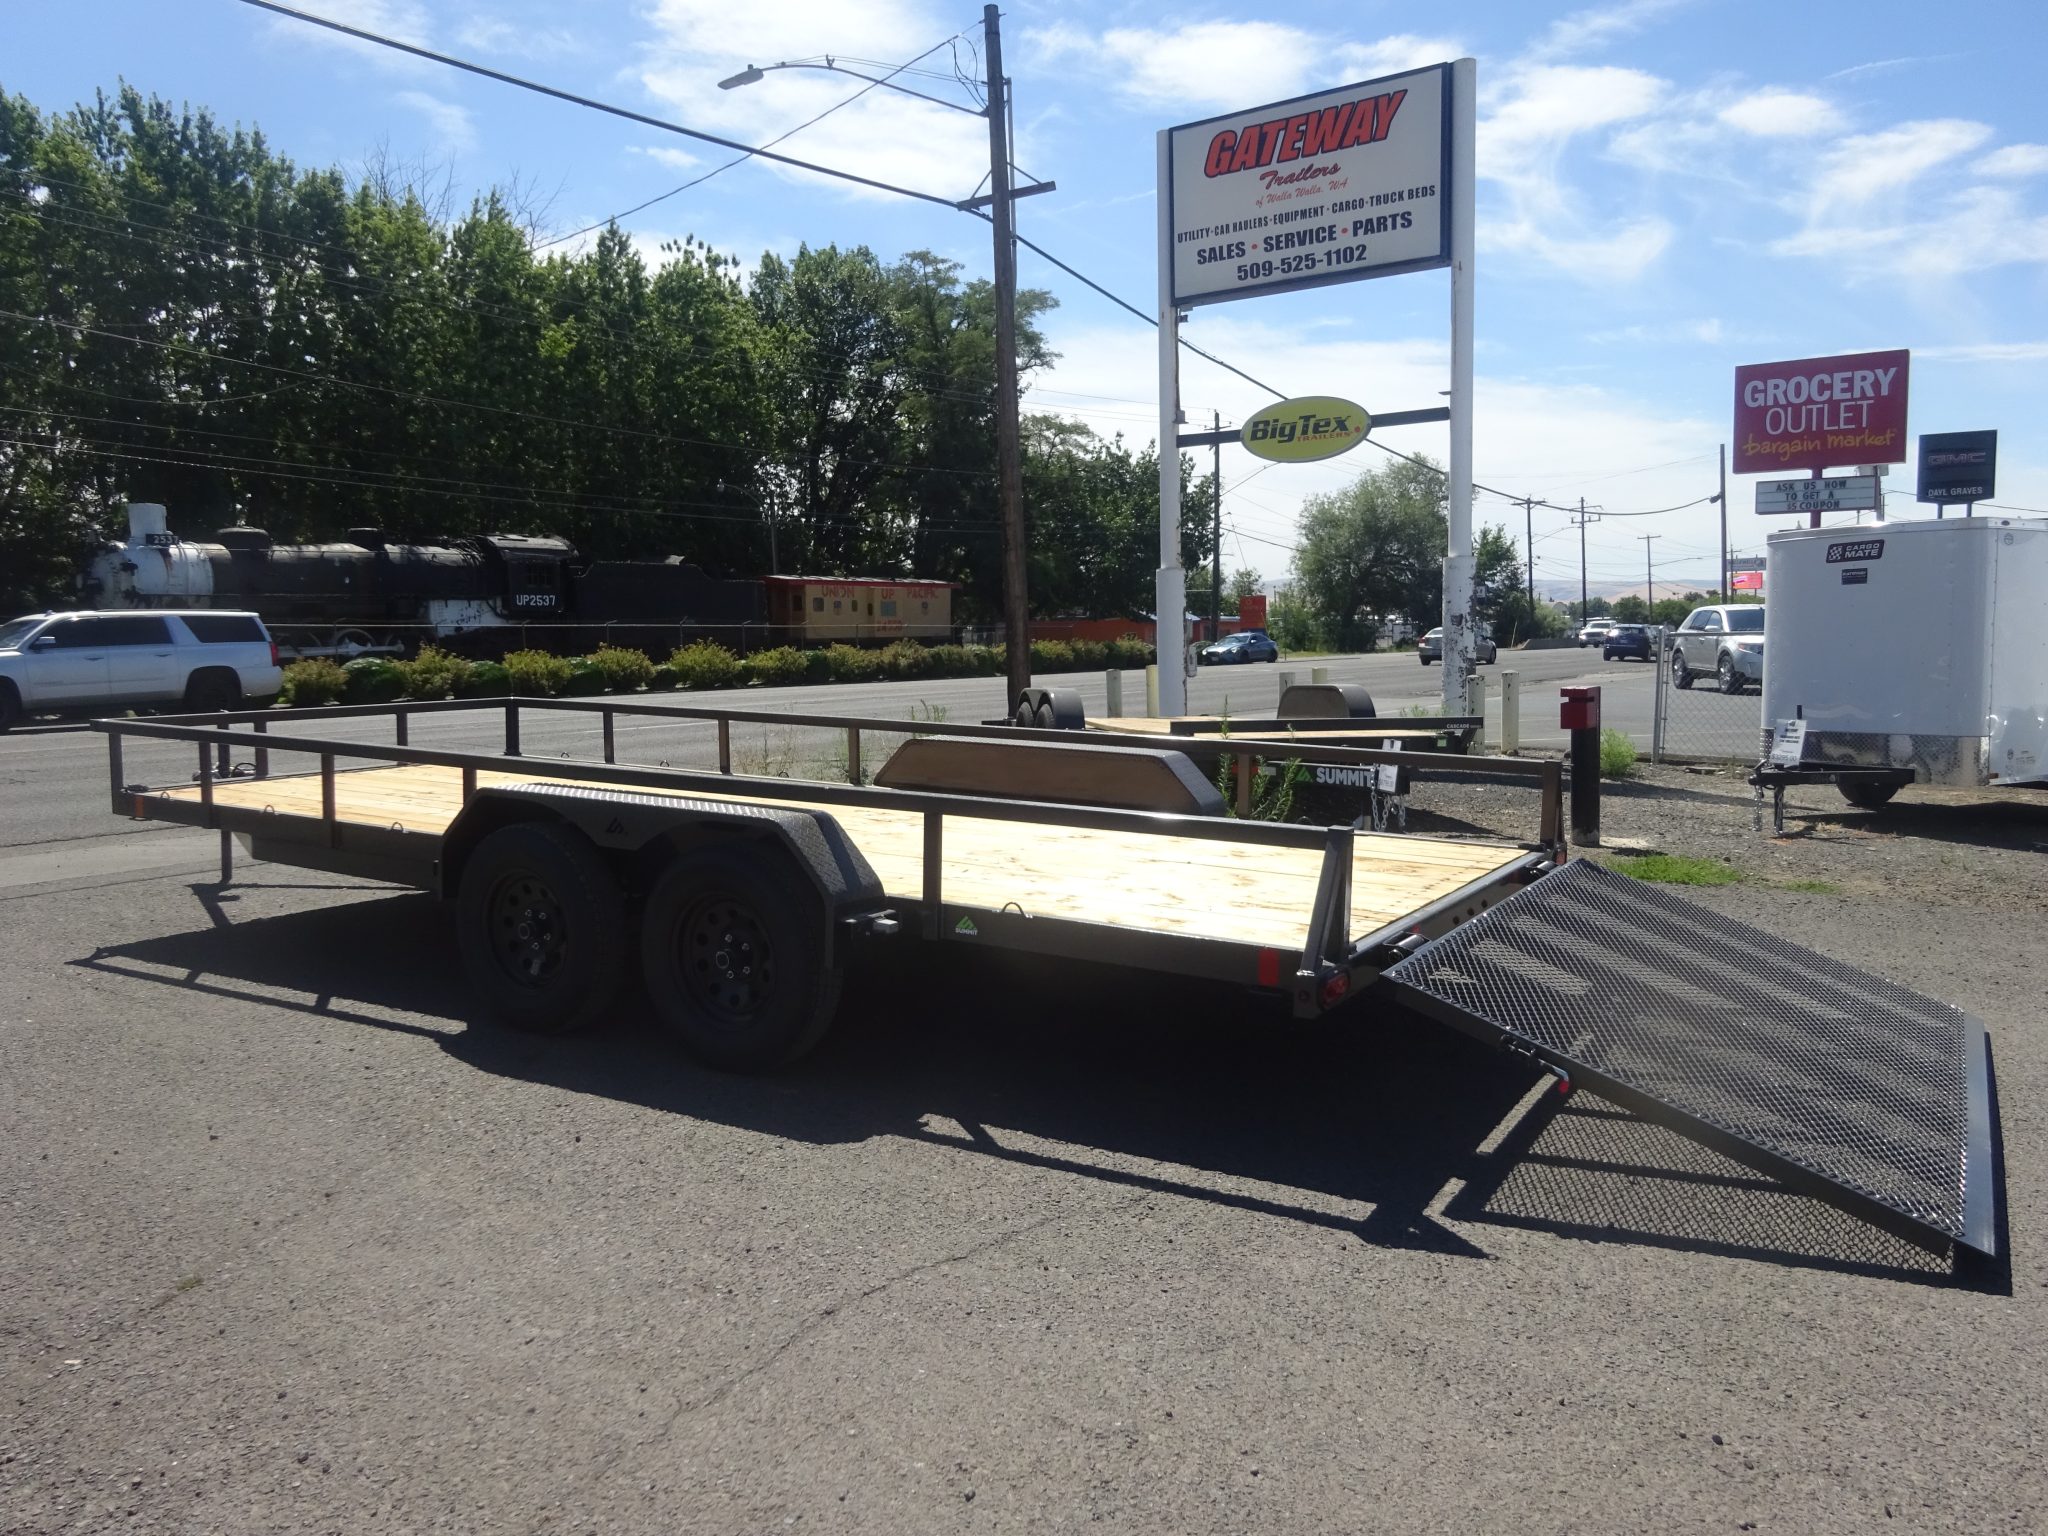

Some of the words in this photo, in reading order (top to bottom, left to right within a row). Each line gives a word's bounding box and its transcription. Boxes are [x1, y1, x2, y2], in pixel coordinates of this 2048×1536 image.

[1204, 89, 1408, 178] GATEWAY
[1259, 163, 1341, 189] Trailers
[1266, 191, 1292, 204] Walla
[1177, 227, 1210, 243] UTILITY
[1214, 224, 1230, 236] CAR
[1232, 216, 1268, 232] HAULERS
[1273, 206, 1324, 225] EQUIPMENT
[1332, 198, 1364, 214] CARGO
[1369, 190, 1404, 207] TRUCK
[1407, 185, 1435, 200] BEDS
[1197, 241, 1246, 265] SALES
[1263, 224, 1337, 253] SERVICE
[1352, 211, 1413, 237] PARTS
[1237, 244, 1367, 281] 509-525-1102
[1744, 367, 1898, 408] GROCERY
[1765, 400, 1874, 435] OUTLET
[1742, 433, 1821, 461] bargain
[1827, 429, 1895, 449] market
[1928, 452, 1986, 466] GMC
[1775, 483, 1794, 492] ASK
[1803, 481, 1816, 490] US
[1824, 480, 1847, 489] HOW
[1950, 487, 1983, 496] GRAVES
[1785, 492, 1797, 501] TO
[1803, 491, 1821, 500] GET
[1828, 491, 1834, 499] A
[1799, 501, 1840, 510] COUPON
[153, 535, 179, 544] 2537
[1845, 549, 1879, 558] MATE
[1846, 543, 1880, 551] CARGO
[822, 586, 855, 598] UNION
[516, 594, 556, 606] UP2537
[1316, 767, 1373, 788] SUMMIT
